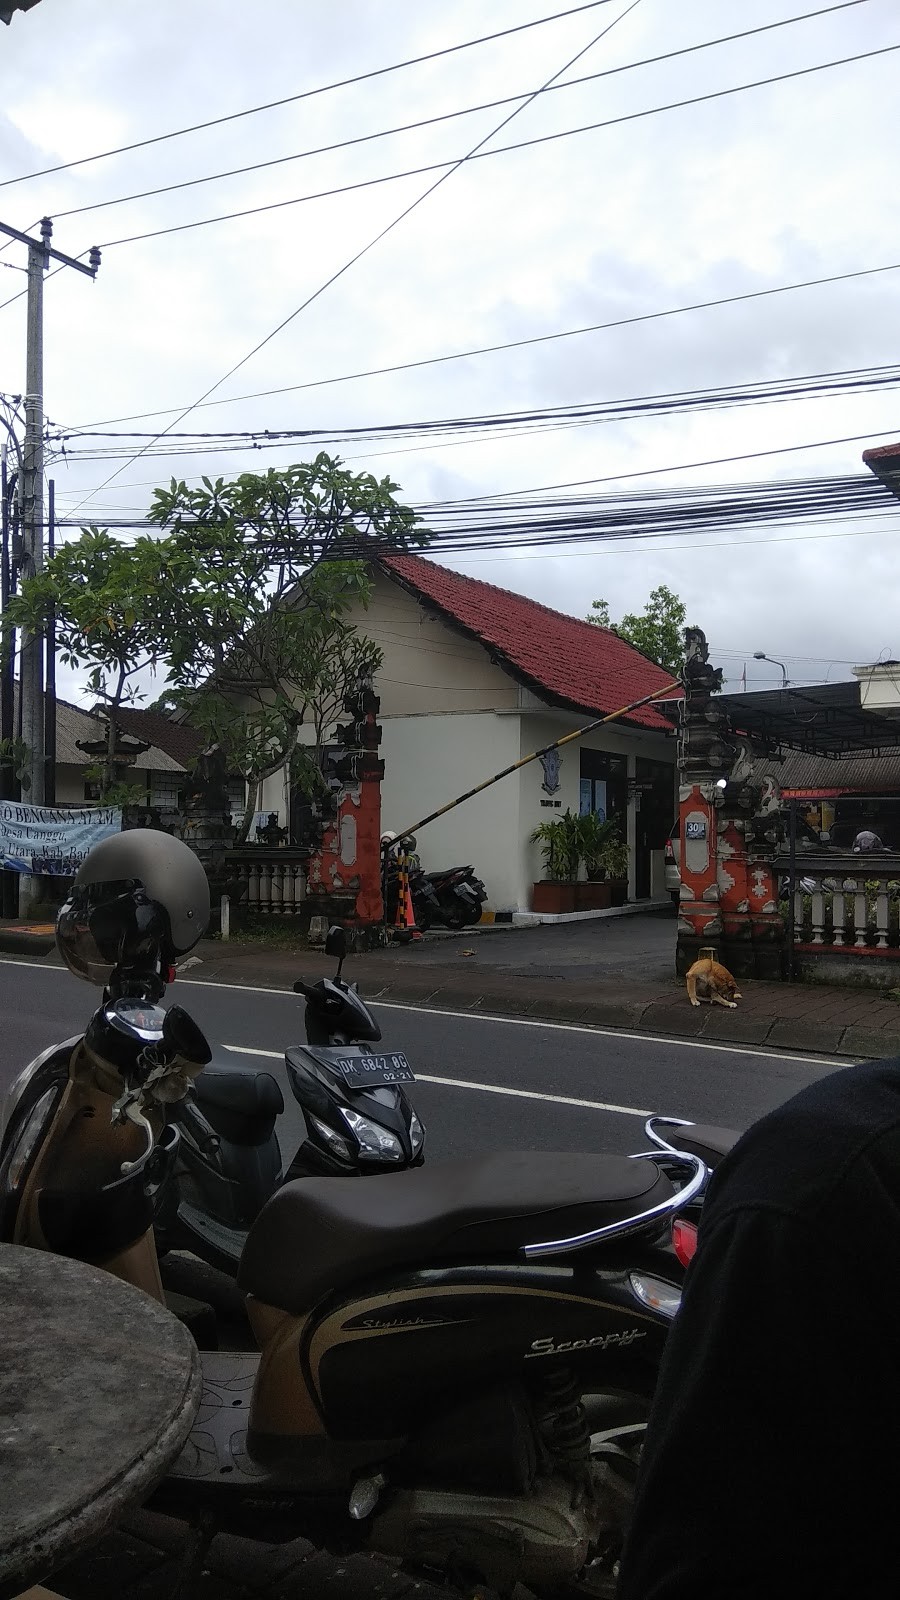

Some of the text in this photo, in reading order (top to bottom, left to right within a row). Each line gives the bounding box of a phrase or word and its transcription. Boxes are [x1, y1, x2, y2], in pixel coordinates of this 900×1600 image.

[16, 807, 75, 825] BENCANA
[78, 809, 114, 825] ALAM
[1, 825, 67, 844] Desa Canggu,
[69, 846, 90, 861] Bad
[340, 1060, 358, 1074] DK
[361, 1056, 389, 1071] 6842
[524, 1329, 648, 1359] Scoopy
